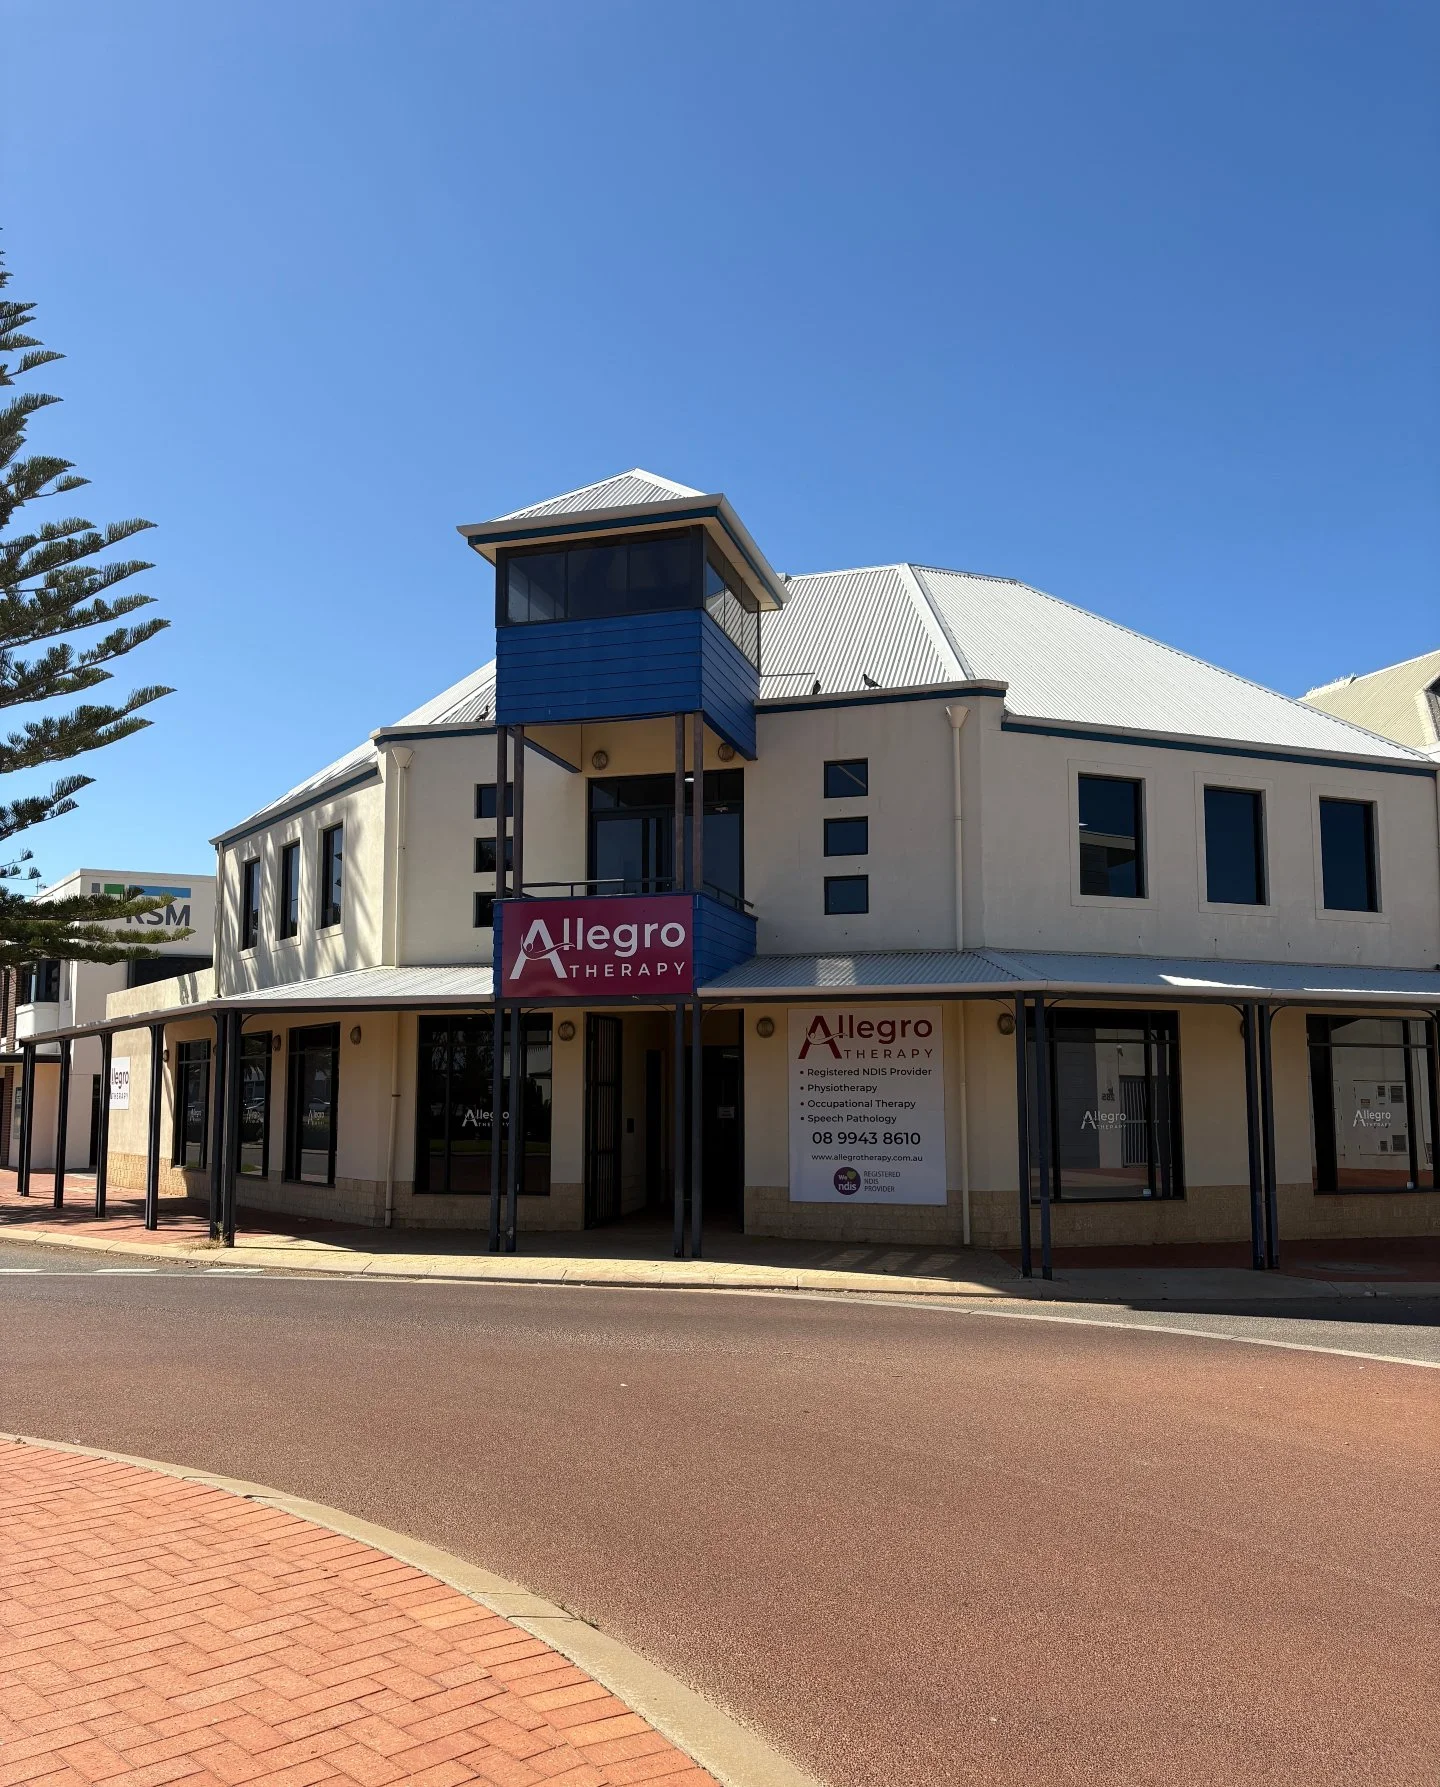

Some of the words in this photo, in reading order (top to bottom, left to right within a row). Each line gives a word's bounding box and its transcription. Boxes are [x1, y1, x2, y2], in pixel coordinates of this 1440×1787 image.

[509, 917, 686, 979] Allegro
[569, 961, 686, 978] THERAPY
[798, 1015, 933, 1059] Allegro
[844, 1049, 933, 1059] THERAPY
[807, 1068, 859, 1077] Registered
[863, 1067, 887, 1076] NDIS
[890, 1067, 932, 1076] Provider
[111, 1068, 129, 1089] llegro
[807, 1084, 878, 1093] Physiotherapy
[807, 1100, 873, 1109] Occupational
[875, 1100, 917, 1109] Therapy
[807, 1115, 844, 1123] Speech
[846, 1115, 897, 1124] Pathology
[1080, 1110, 1127, 1130] Allegro
[1353, 1109, 1391, 1127] Allegro
[812, 1132, 833, 1144] 08
[838, 1132, 878, 1144] 9943
[883, 1132, 921, 1145] 8610
[811, 1154, 923, 1162] www.allegrotherapy.com.au
[838, 1181, 857, 1191] ndis
